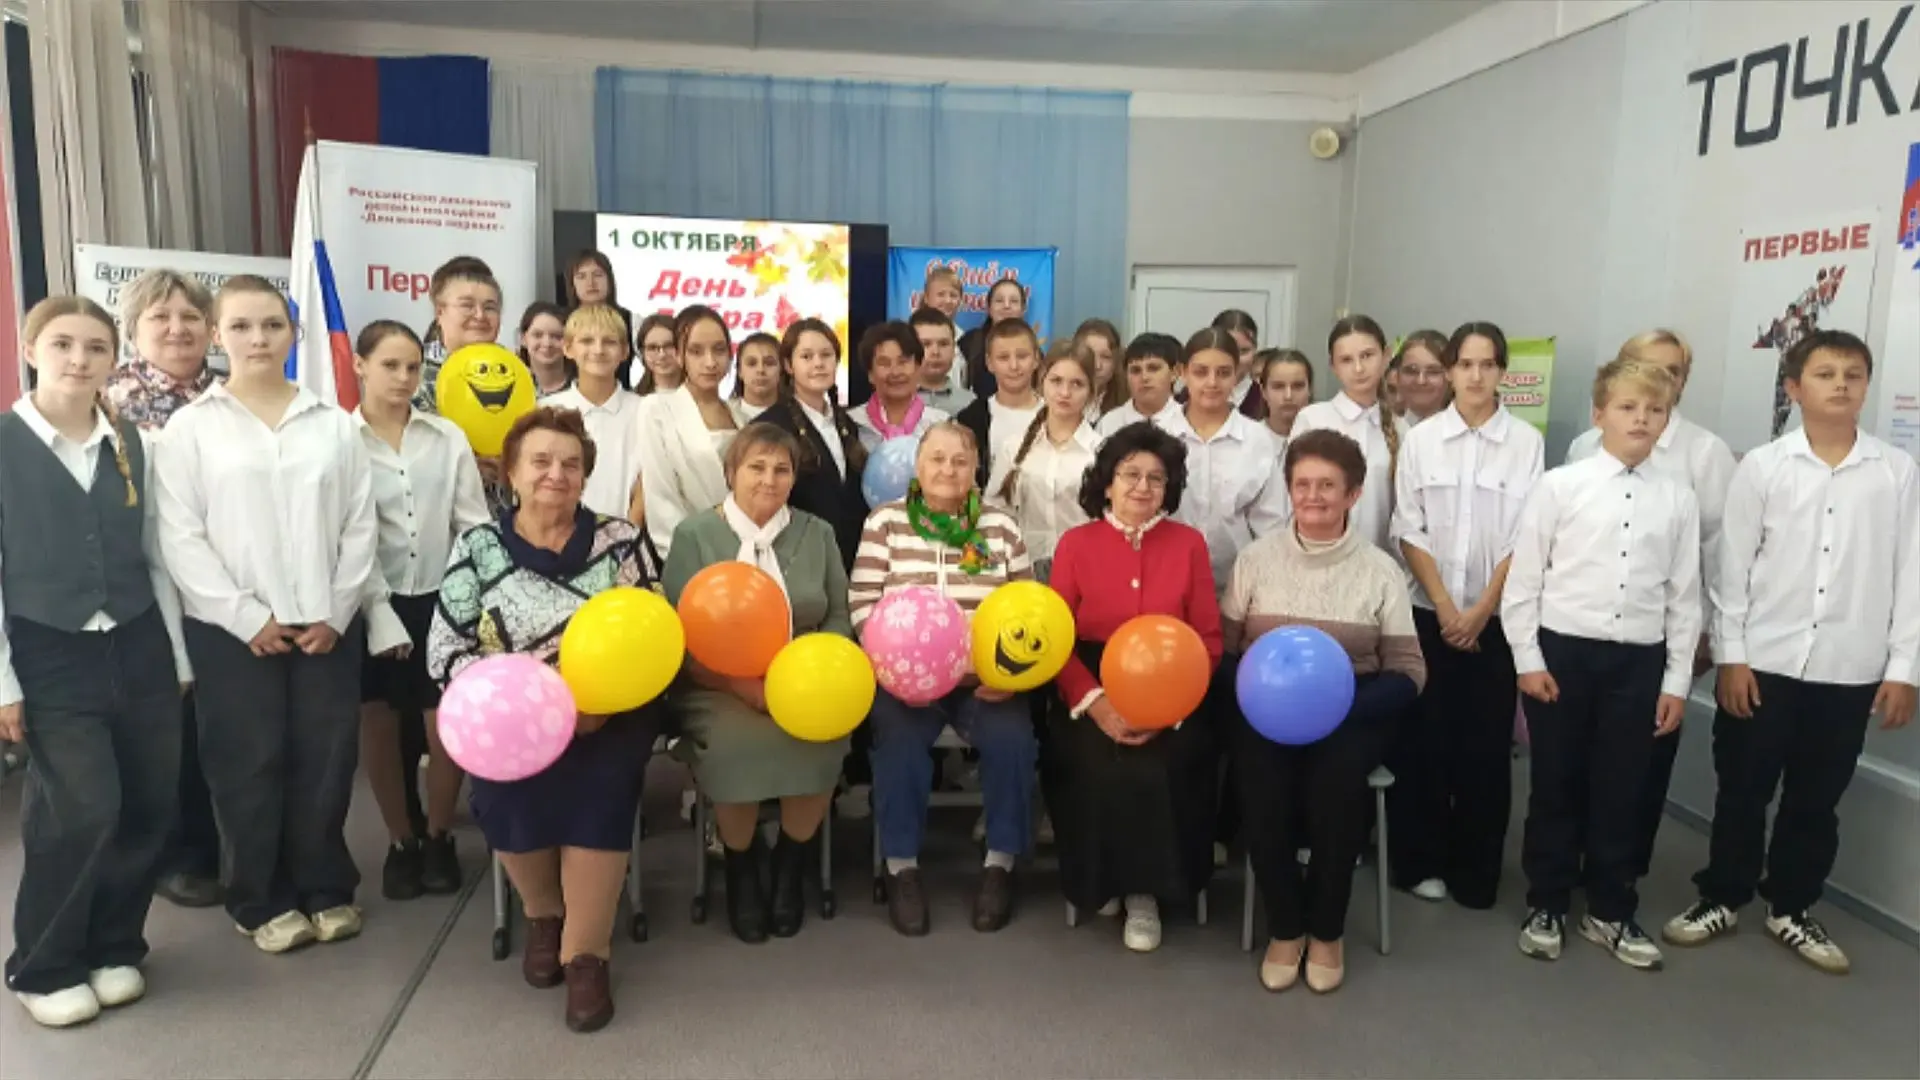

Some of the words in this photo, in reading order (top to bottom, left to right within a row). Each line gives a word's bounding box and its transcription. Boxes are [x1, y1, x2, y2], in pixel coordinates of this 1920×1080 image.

[1687, 3, 1920, 156] ТОЧК
[608, 228, 619, 247] 1
[632, 230, 757, 253] ОКТЯБРЯ
[1743, 223, 1871, 263] ПЕРВЫЕ
[367, 264, 431, 301] Пер
[648, 270, 747, 301] День
